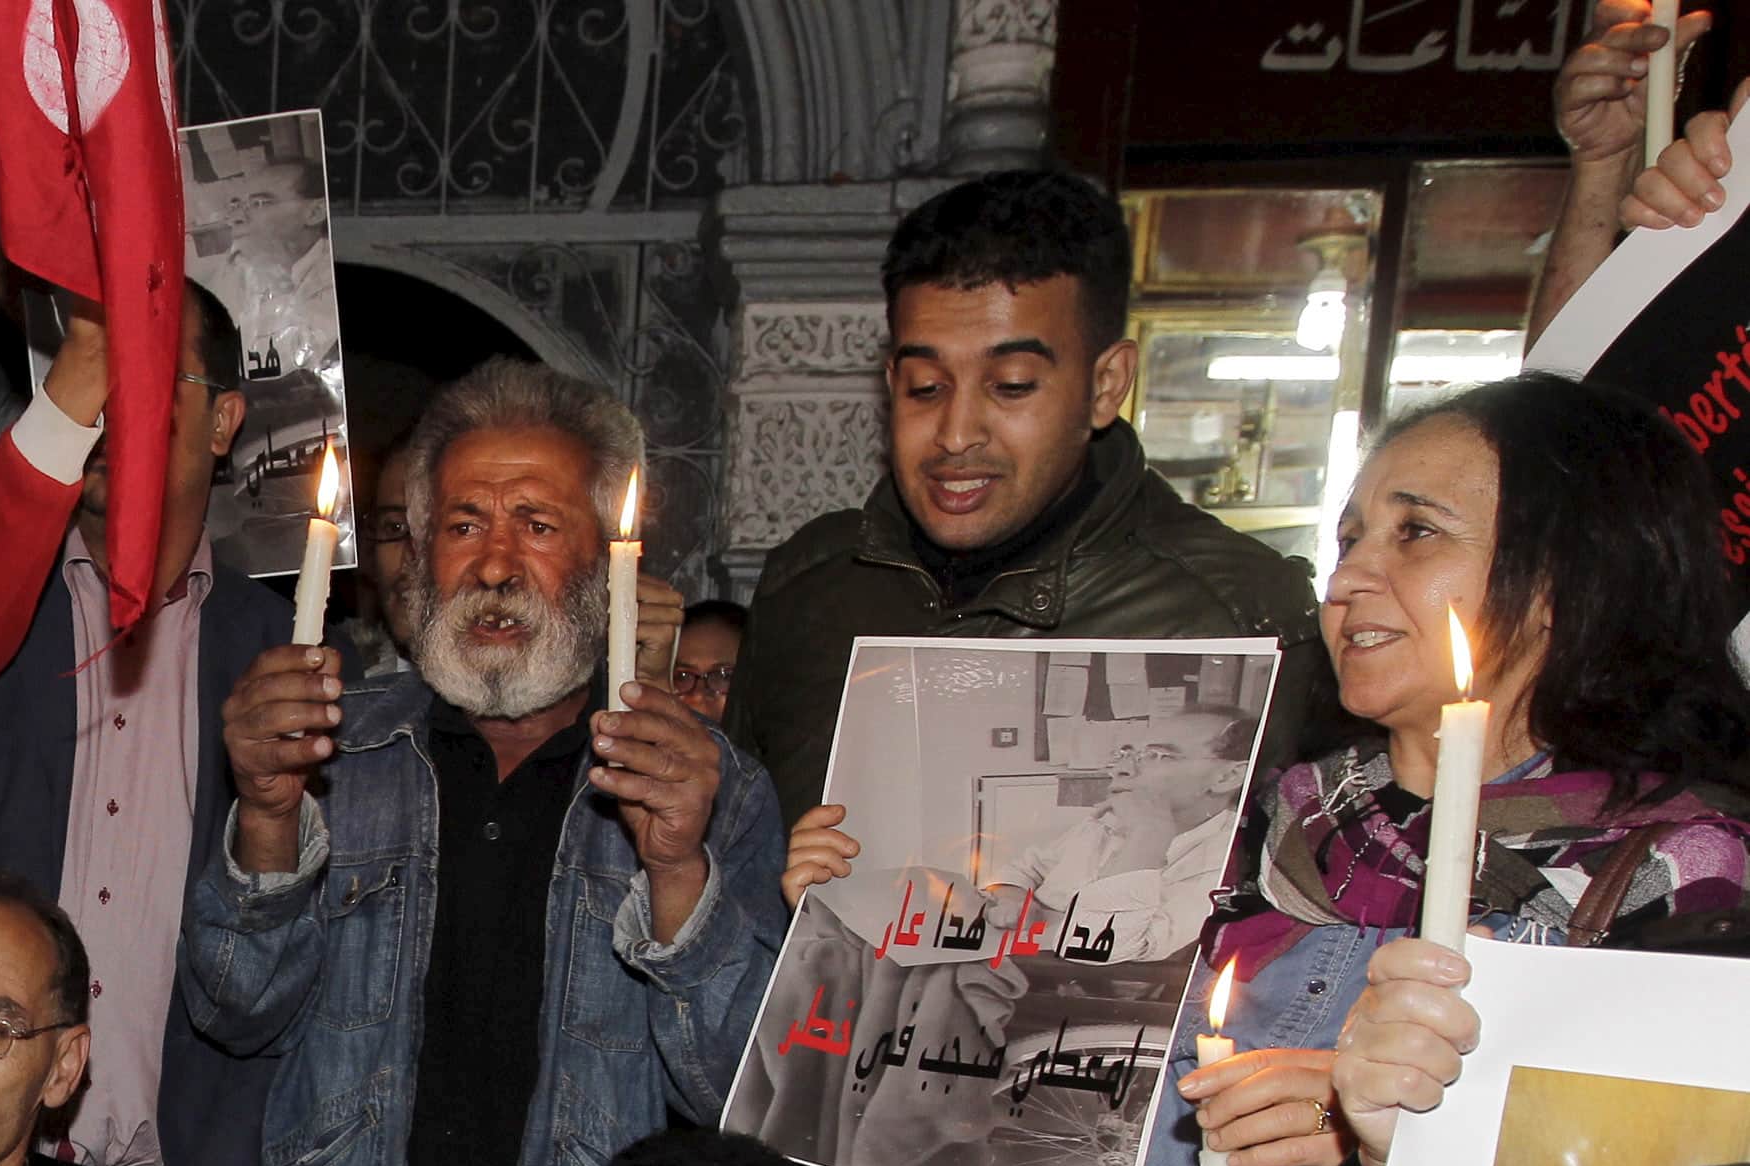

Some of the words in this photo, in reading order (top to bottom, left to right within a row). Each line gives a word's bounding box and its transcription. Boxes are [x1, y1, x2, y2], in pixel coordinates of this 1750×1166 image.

[874, 879, 927, 961] عار
[933, 881, 987, 951] هدا
[990, 887, 1047, 970] عار
[1054, 890, 1116, 963] هدا
[852, 1001, 917, 1094] في
[917, 1026, 1008, 1095] منجب
